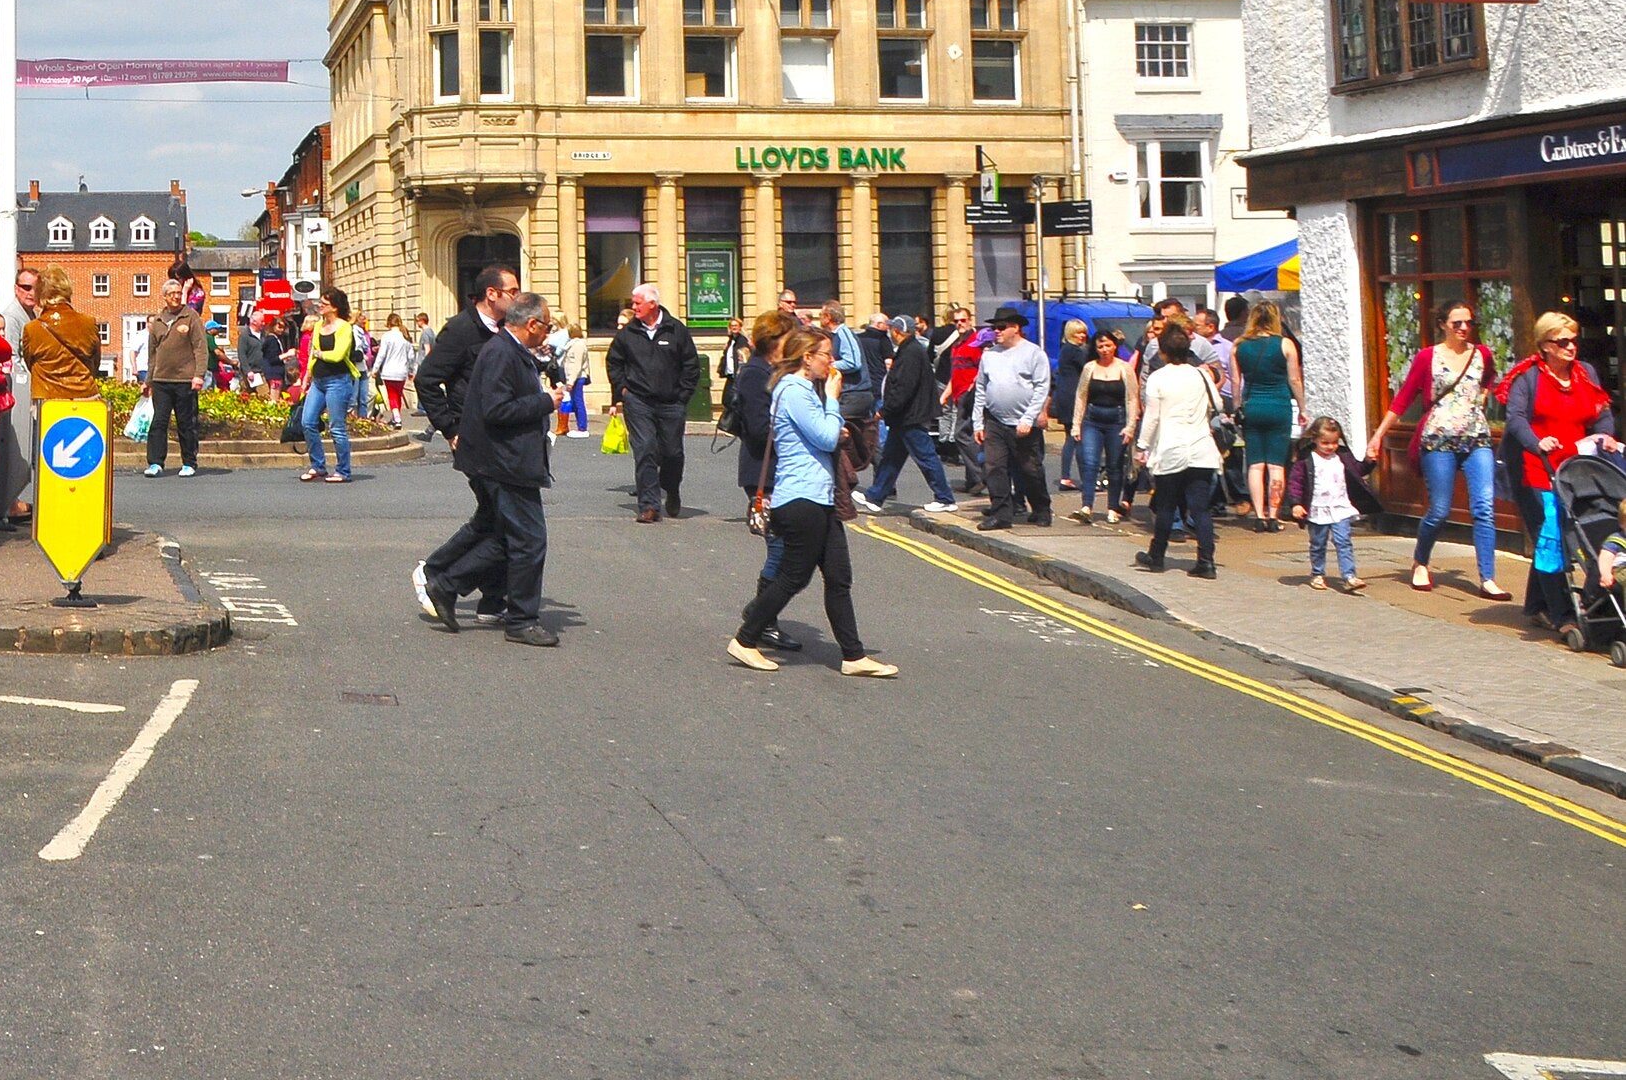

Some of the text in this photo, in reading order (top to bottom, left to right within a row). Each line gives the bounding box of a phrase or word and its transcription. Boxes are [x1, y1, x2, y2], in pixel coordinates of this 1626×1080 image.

[34, 63, 65, 72] Whole
[66, 63, 96, 72] School
[97, 62, 124, 72] Open
[125, 62, 163, 71] Morning
[735, 146, 907, 170] LLOYDS BANK
[1540, 135, 1598, 163] Crabtree
